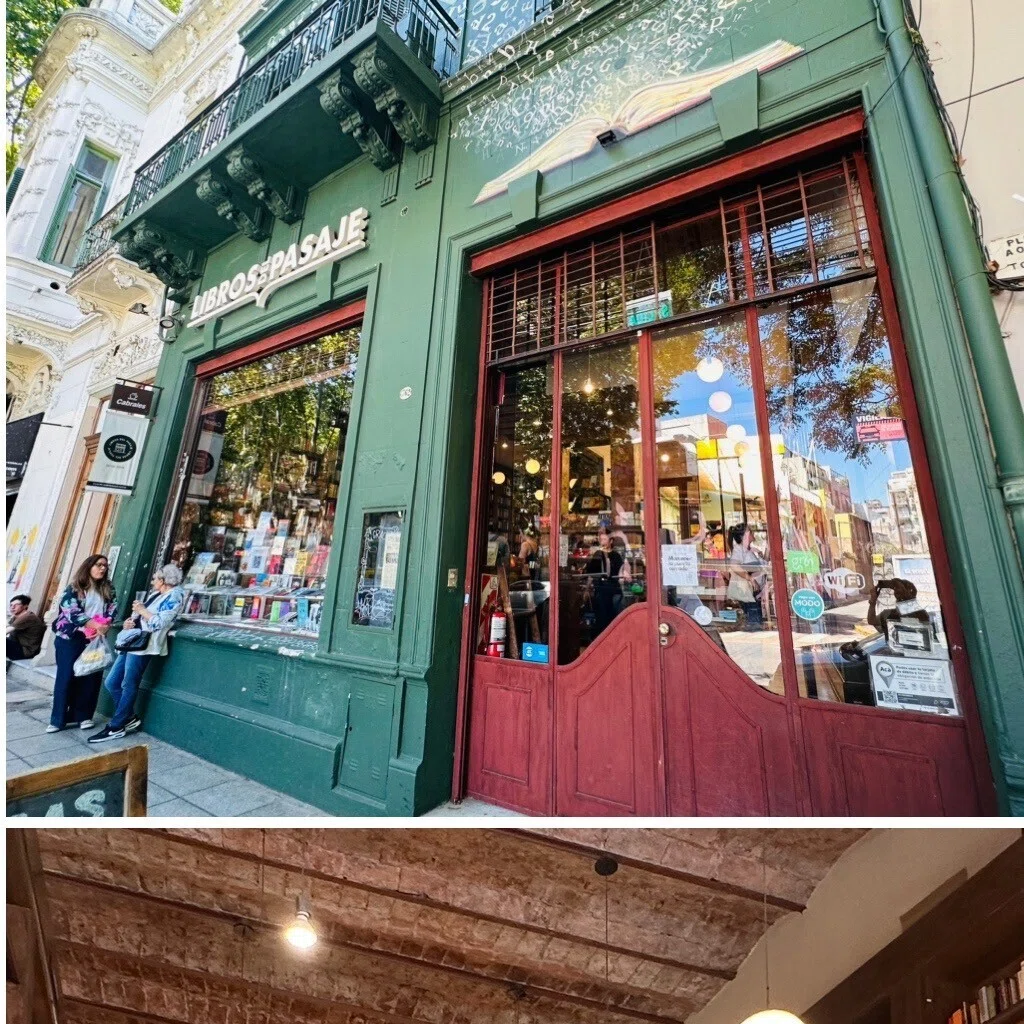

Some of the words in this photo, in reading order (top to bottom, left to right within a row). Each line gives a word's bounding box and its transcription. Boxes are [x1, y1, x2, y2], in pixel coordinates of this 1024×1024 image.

[190, 263, 261, 319] LIBROS
[269, 206, 370, 280] PASAJE
[116, 398, 146, 409] Cabrales
